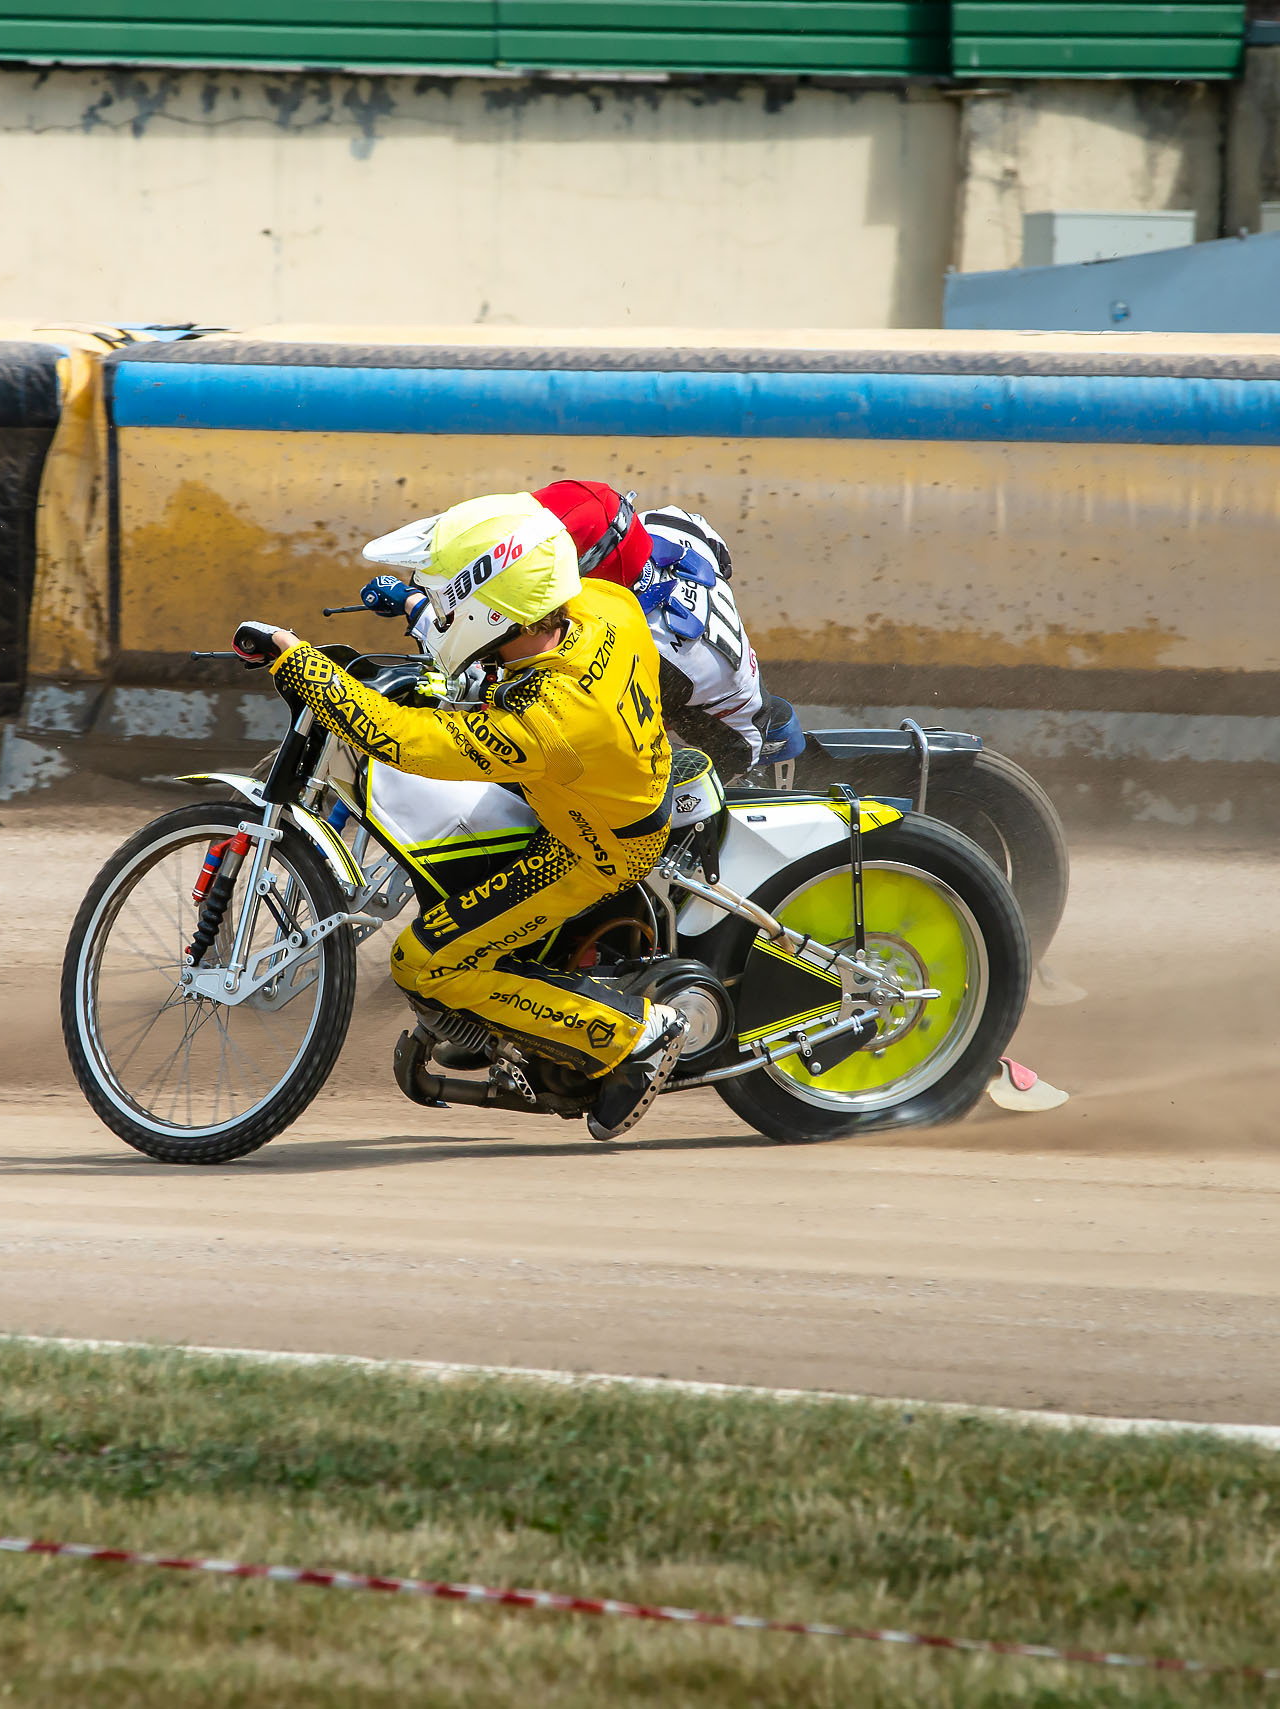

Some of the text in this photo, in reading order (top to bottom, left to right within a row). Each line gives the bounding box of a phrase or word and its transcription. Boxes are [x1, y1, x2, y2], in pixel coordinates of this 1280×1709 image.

[443, 535, 523, 609] 100%
[325, 684, 400, 763] SALVA
[630, 679, 655, 728] 4
[470, 716, 513, 755] LOTTO
[458, 844, 560, 910] POL-CAR
[489, 991, 588, 1030] spechouse
